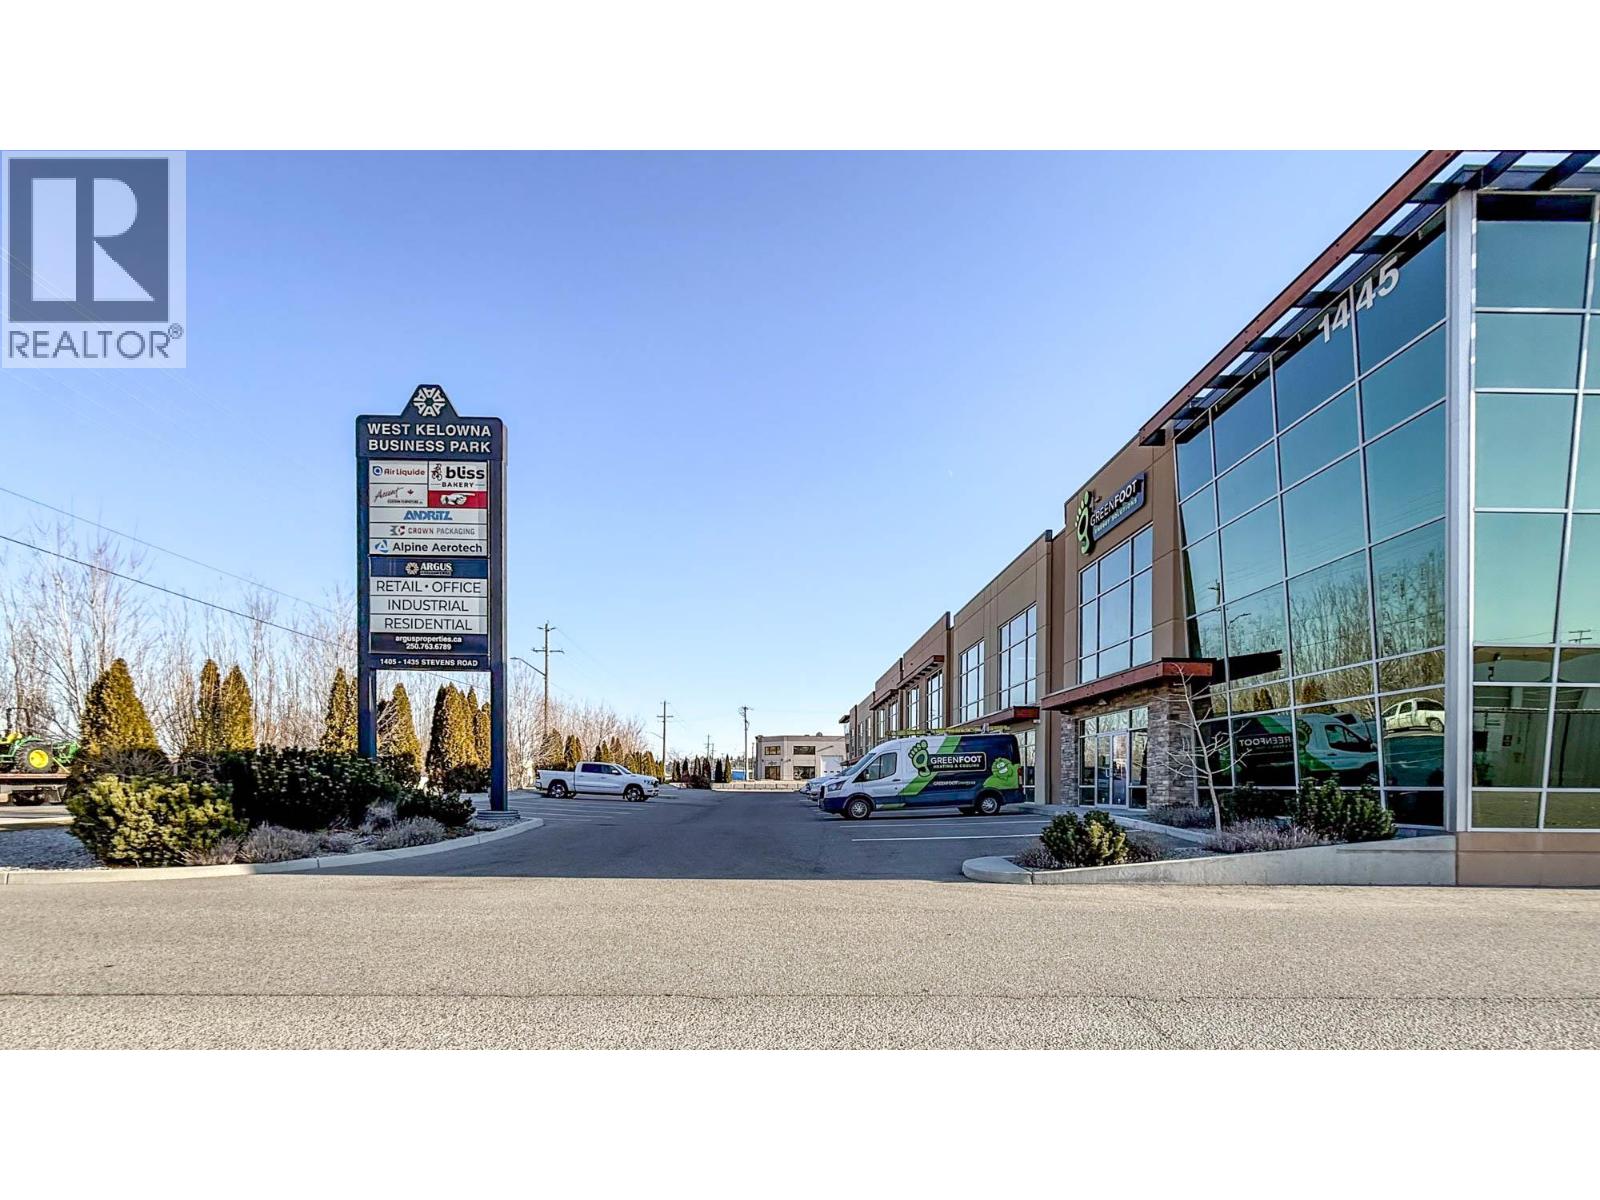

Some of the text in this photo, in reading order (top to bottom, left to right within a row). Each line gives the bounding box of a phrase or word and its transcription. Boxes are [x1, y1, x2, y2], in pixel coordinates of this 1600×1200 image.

[1318, 255, 1400, 343] 1445
[367, 422, 492, 437] WEST KELOWNA
[368, 436, 491, 453] BUSINESS PARK
[384, 468, 425, 477] Air Liquide
[445, 465, 485, 480] bliss
[1090, 479, 1138, 527] GREENFOOT
[403, 510, 453, 521] ANDRITZ
[407, 527, 476, 536] CROWN PACKAGING
[392, 542, 483, 553] Alpine Aerotech
[420, 562, 453, 571] ARGUS
[376, 580, 482, 594] RETAIL OFFICE
[387, 599, 470, 612] INDUSTRIAL
[385, 617, 473, 631] RESIDENTIAL
[395, 635, 462, 643] argusproperties.ca
[421, 659, 456, 667] STEVENS
[930, 755, 983, 765] GREENFOOT
